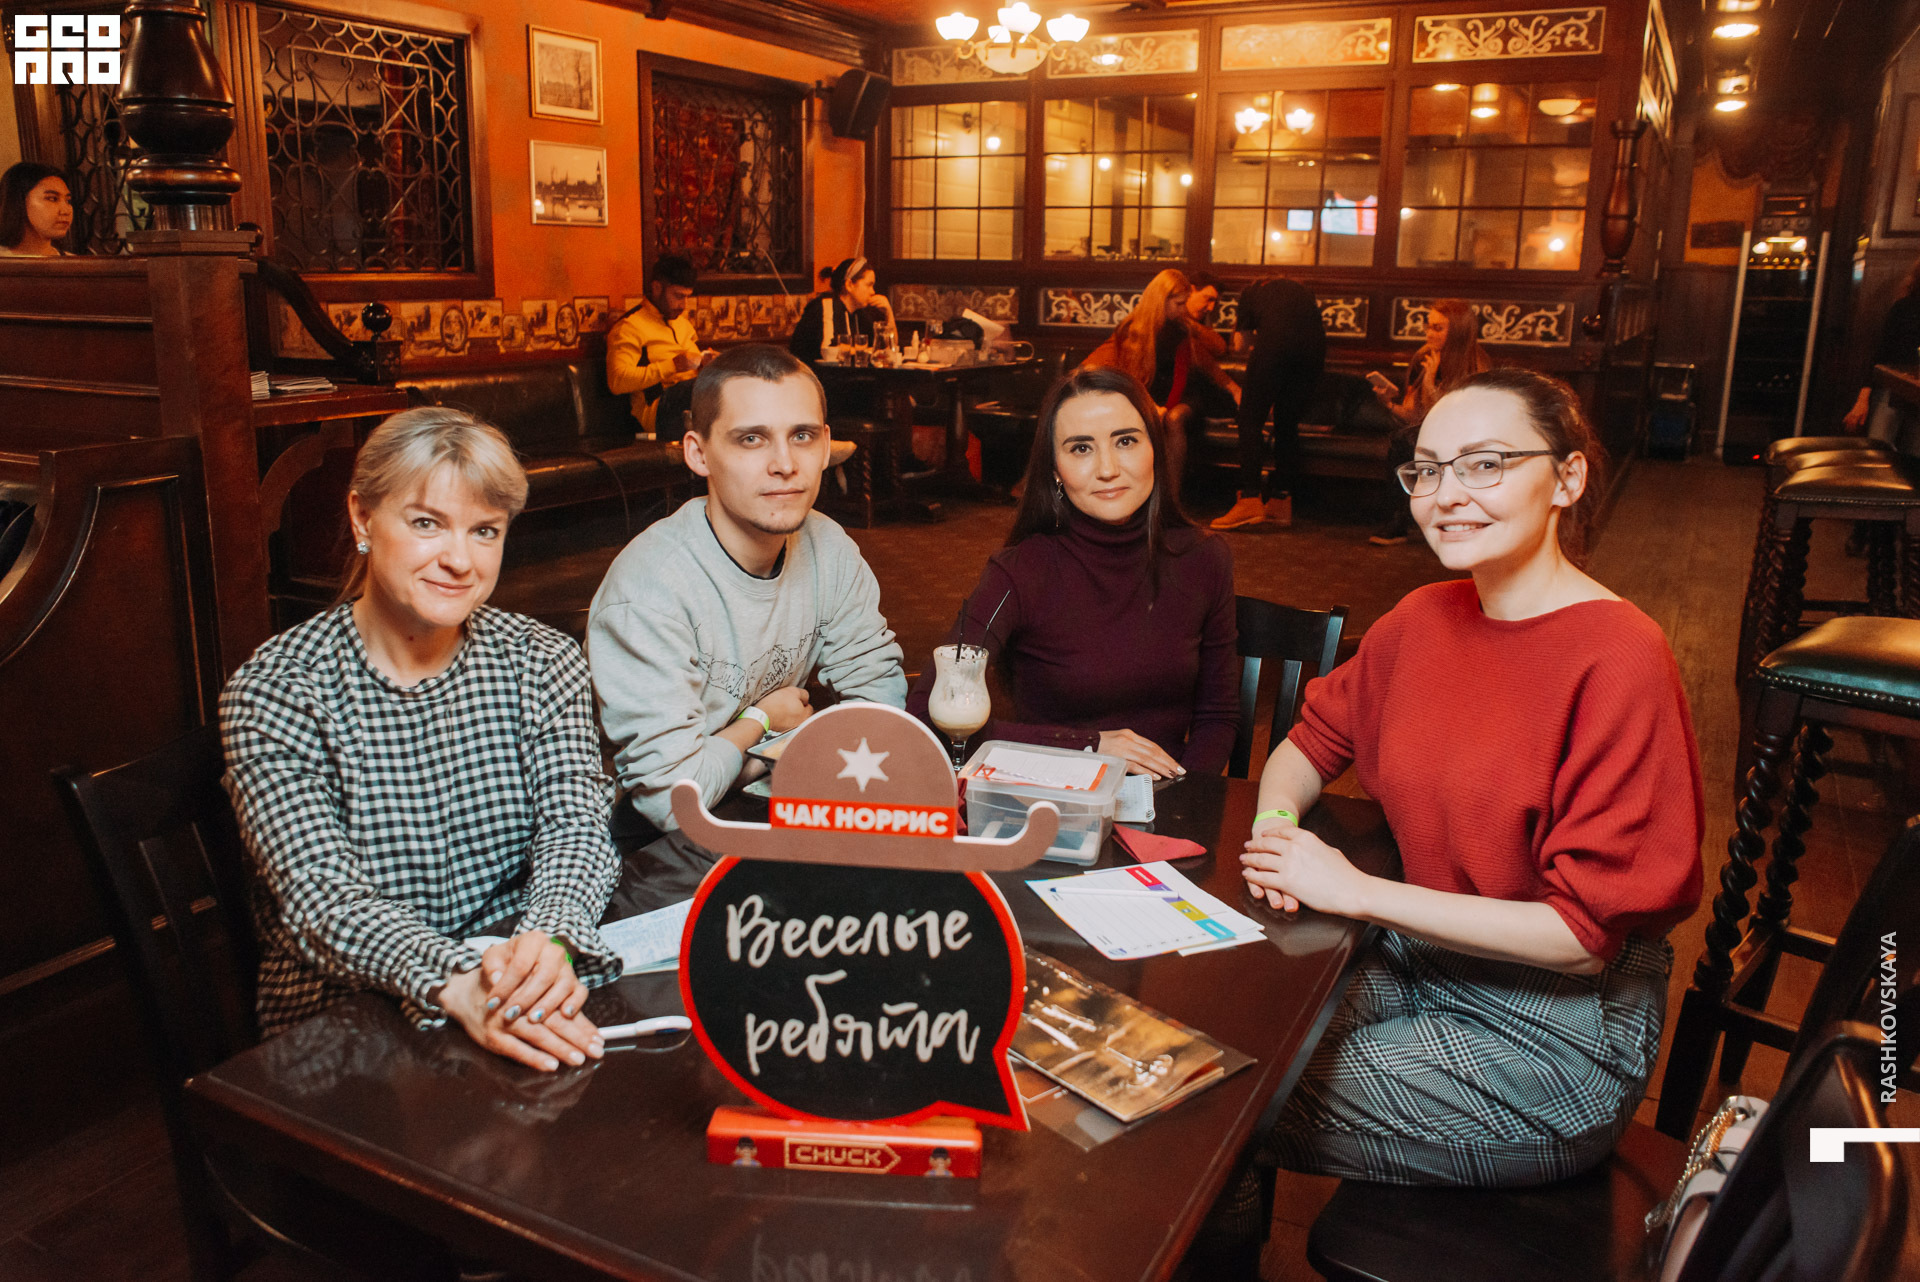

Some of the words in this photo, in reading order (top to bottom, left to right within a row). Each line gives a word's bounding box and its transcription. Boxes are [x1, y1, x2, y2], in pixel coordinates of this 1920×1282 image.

[775, 802, 831, 827] ЧАК
[835, 806, 948, 835] НОРРИС
[726, 895, 973, 968] Веселые
[745, 969, 981, 1076] ребята
[795, 1145, 883, 1167] CHUCK
